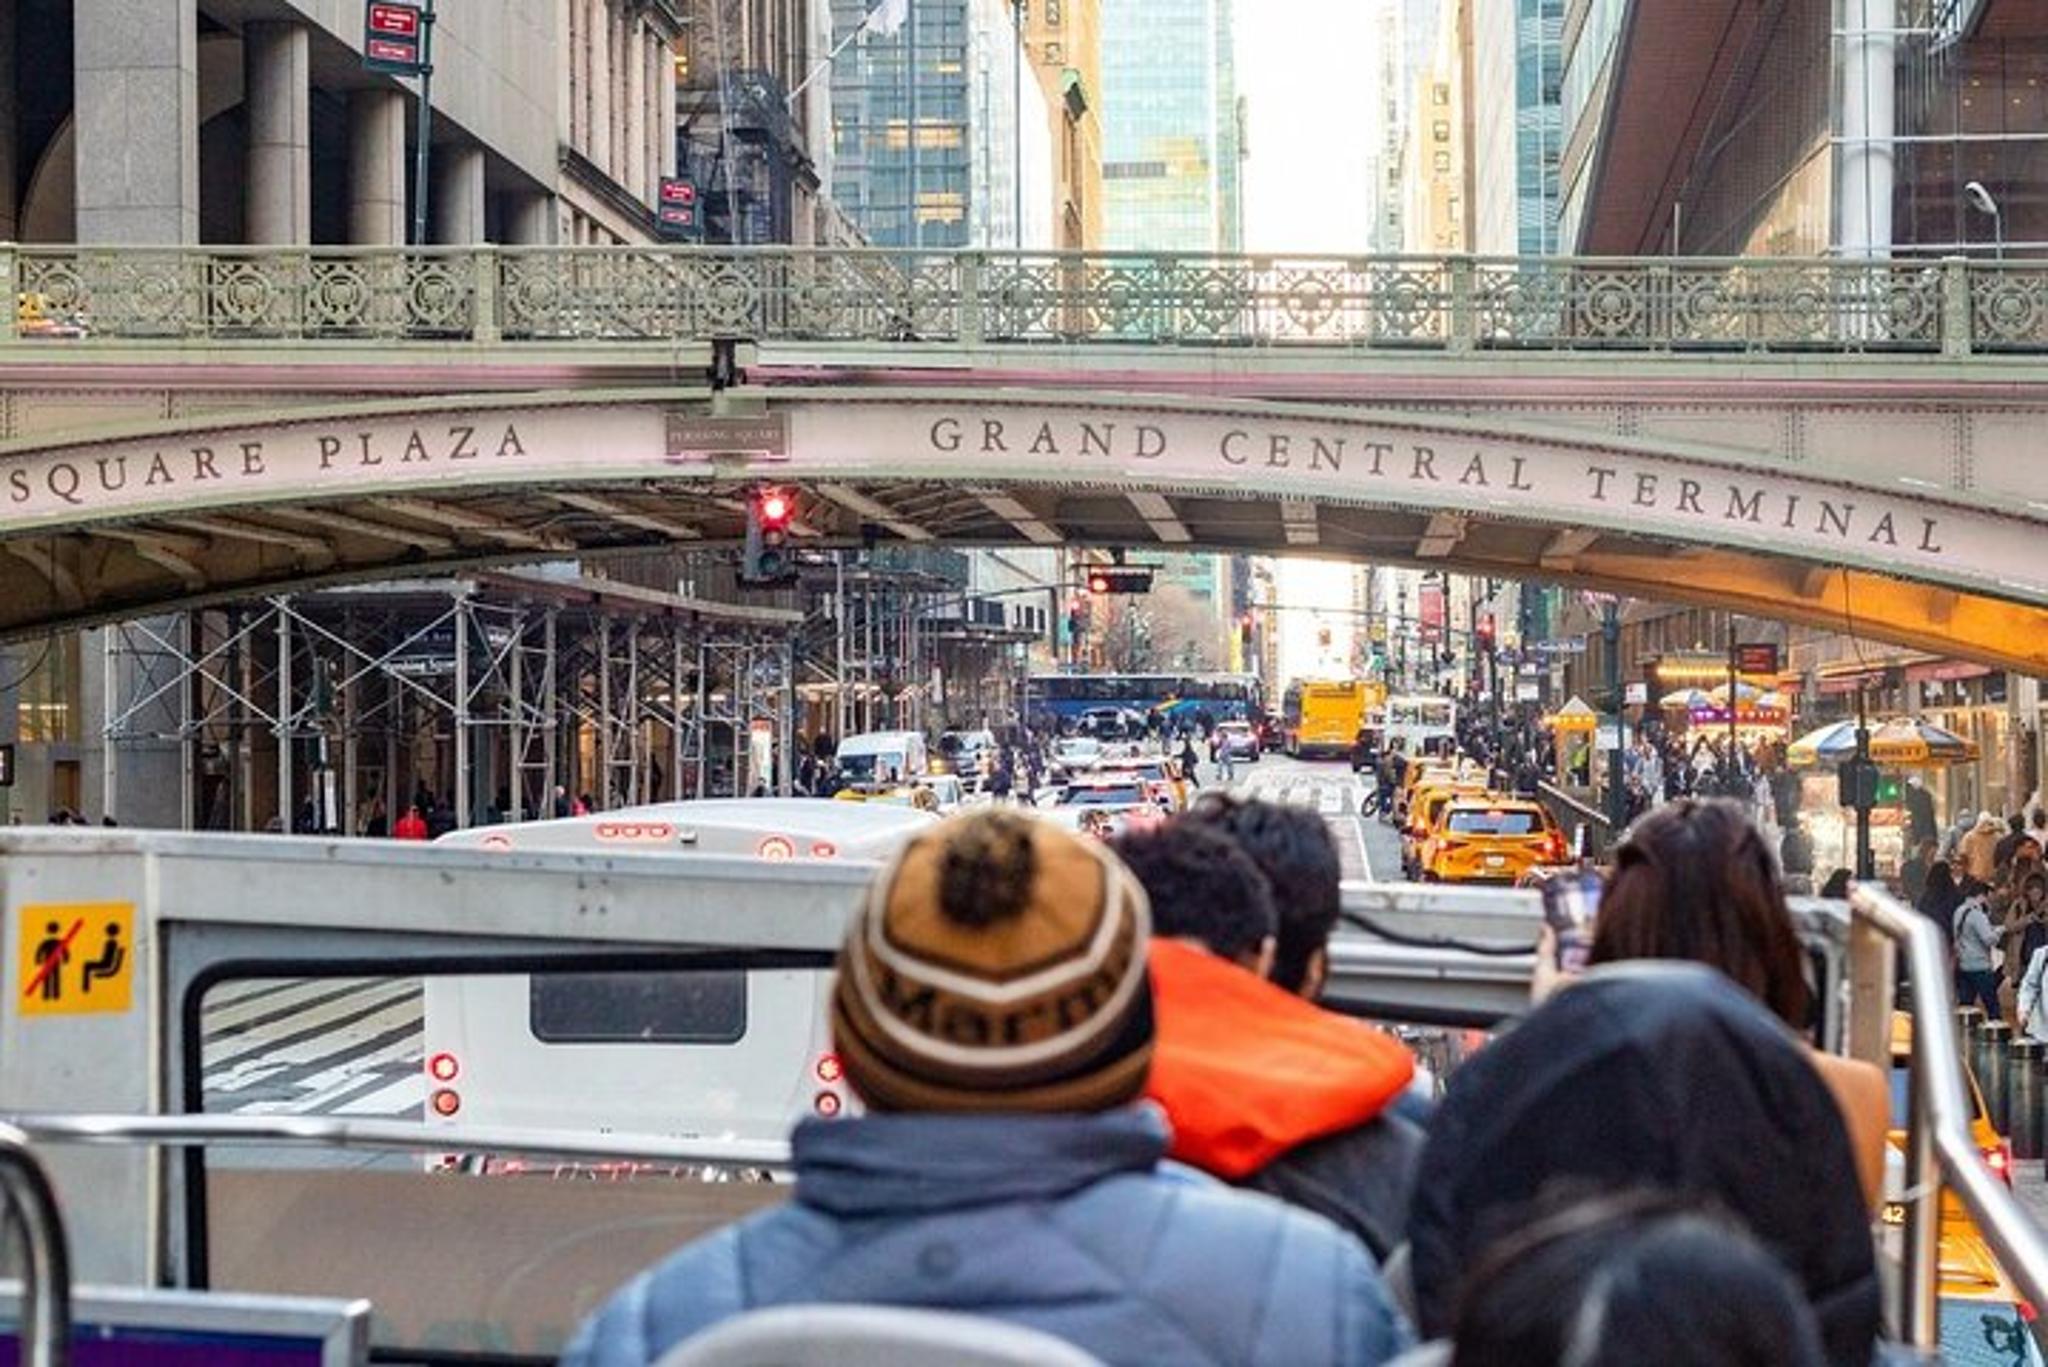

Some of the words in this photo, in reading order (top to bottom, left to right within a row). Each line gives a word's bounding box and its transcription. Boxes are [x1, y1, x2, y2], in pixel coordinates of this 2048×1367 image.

[9, 442, 266, 505] SQUARE
[317, 424, 526, 469] PLAZA
[930, 418, 1167, 459] GRAND
[1220, 430, 1532, 491] CENTRAL
[1587, 466, 1941, 553] TERMINAL
